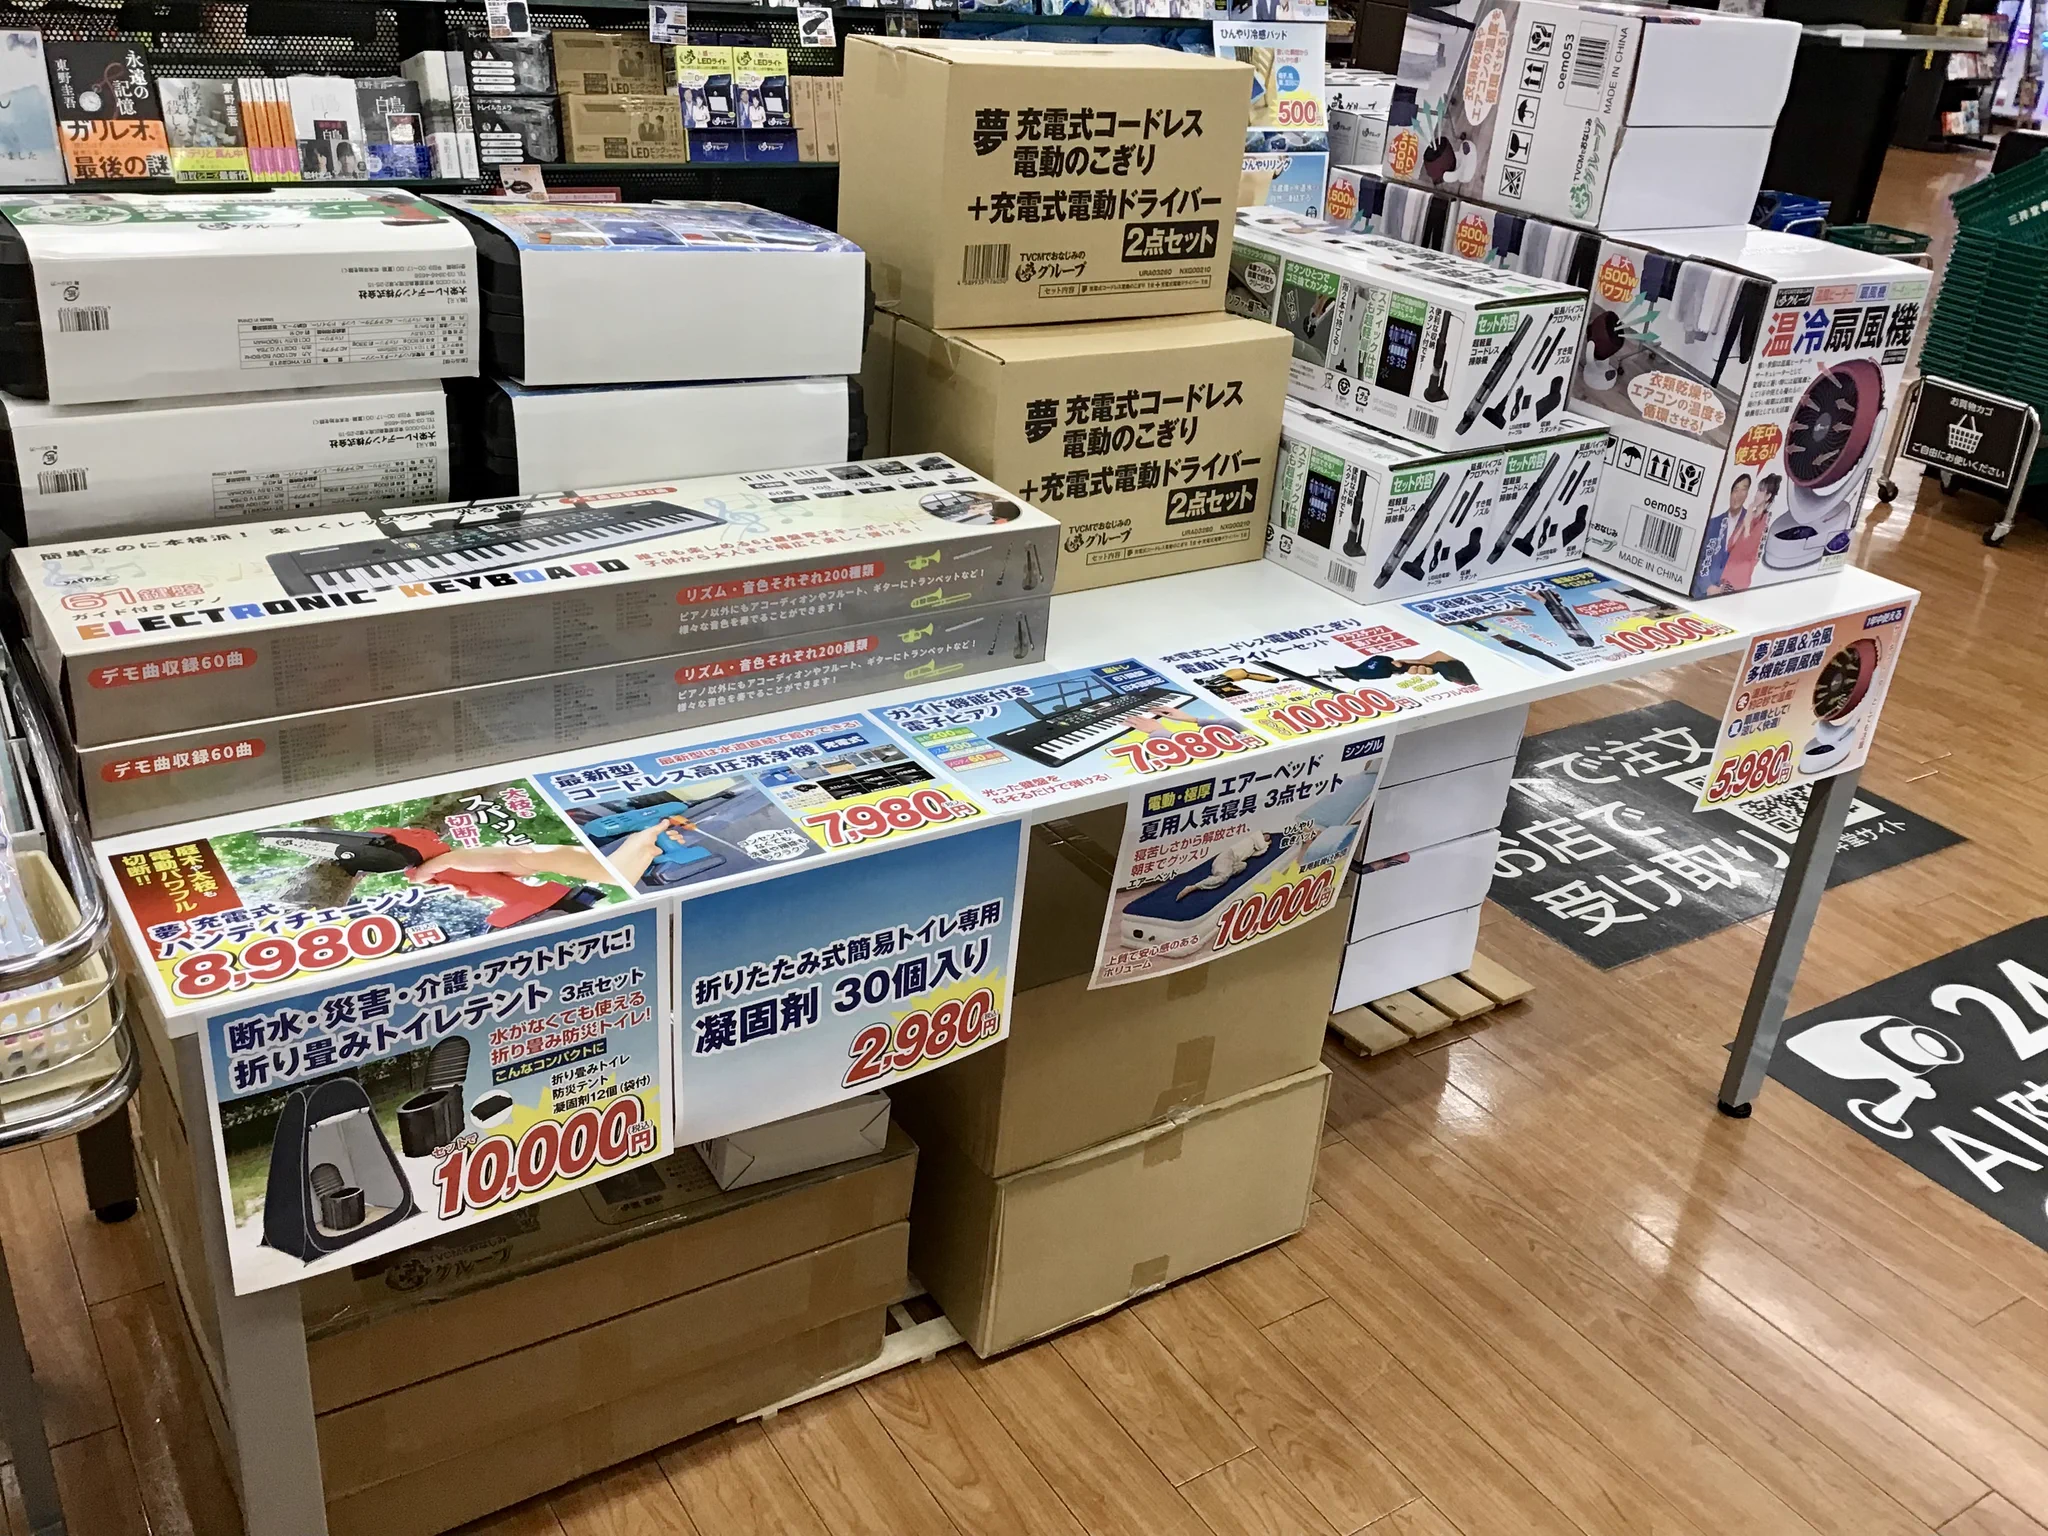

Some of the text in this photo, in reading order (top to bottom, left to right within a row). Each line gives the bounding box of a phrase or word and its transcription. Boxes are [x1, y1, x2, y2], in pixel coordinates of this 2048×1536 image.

[126, 50, 150, 99] 永遠の
[753, 58, 782, 66] LEDライト
[1471, 11, 1501, 121] エアコンの温度を
[1557, 33, 1576, 90] oem053
[1603, 80, 1618, 115] MADE
[1613, 26, 1629, 63] CHINA
[55, 58, 76, 109] 東野圭吾
[113, 80, 137, 116] 記憶
[222, 83, 239, 128] 東野圭吾
[375, 96, 406, 115] 白鳥
[451, 84, 474, 133] 架空犯
[973, 107, 1204, 156] 夢 充電式コードレス
[74, 155, 172, 179] 最後の謎
[631, 147, 649, 159] LED
[1013, 144, 1156, 178] 電動のこぎり
[1020, 250, 1086, 262] TVCMでおなじみの
[1125, 227, 1214, 257] 2点セット
[358, 285, 468, 300] 大栄トレーディング株式会社
[1860, 286, 1887, 299] 扇風機
[1364, 292, 1388, 381] スティック仕様
[1478, 312, 1520, 333] セット内容
[1762, 302, 1919, 358] 温冷扇風機
[1470, 346, 1500, 356] コードレス
[1554, 357, 1572, 365] ノズル
[1649, 370, 1713, 401] 衣類乾燥や
[1024, 380, 1244, 444] 夢 充電式コードレス
[1631, 383, 1725, 425] エアコンの温度を
[1642, 404, 1704, 435] 循環させる!
[1950, 396, 1995, 417] お買物カゴ
[329, 431, 436, 448] 大栄トレーディング株式会社
[1063, 416, 1199, 459] 電動のこぎり
[1507, 453, 1547, 473] セット内容
[1911, 441, 2006, 479] ご自由にお使いください
[1286, 445, 1308, 529] スティック仕様
[1392, 473, 1434, 493] セット内容
[1501, 484, 1529, 494] コードレス
[1579, 486, 1596, 496] ノズル
[1170, 484, 1253, 520] 2点セット
[1386, 504, 1417, 516] コードレス
[1472, 508, 1490, 518] ノズル
[1643, 496, 1689, 522] oem053
[1069, 518, 1132, 535] TVCMでおなじみの
[686, 563, 875, 603] リズム・音色それぞれ200種類
[1618, 550, 1684, 585] MADE IN CHINA
[61, 583, 206, 612] 61鍵盤
[72, 596, 222, 622] ガイド付きピアノ
[1436, 580, 1551, 610] 超軽量コードレス
[678, 602, 844, 635] 様々な音色を奏でることができます!
[1435, 601, 1526, 623] 掃除機セット
[1158, 618, 1363, 666] 充電式コードレス電動のこぎり
[1174, 637, 1330, 676] 電動ドライバーセット
[1753, 642, 1770, 661] 夢
[101, 651, 244, 686] デモ曲収録60曲
[683, 638, 869, 680] リズム・音色それぞれ200種類
[1746, 651, 1824, 684] 多機能扇風機
[677, 674, 837, 712] 様々な音色を奏でることができます!
[888, 685, 1033, 719] ガイド機能付き
[900, 706, 1001, 733] 電子ピアノ
[821, 735, 864, 751] 充電式
[1344, 739, 1384, 759] シングル
[114, 741, 253, 779] デモ曲収録60曲
[555, 763, 640, 790] 最新型
[567, 743, 819, 802] コードレス高圧洗浄機
[981, 773, 1061, 799] 光った鍵盤を
[992, 773, 1113, 806] なぞるだけで弾ける!
[1148, 752, 1325, 811] 電動・極厚 エアーベッド
[502, 787, 535, 818] 太枝も
[1138, 772, 1344, 843] 夏用人気寝具 3点セット
[459, 793, 534, 849] スパッと
[1133, 825, 1253, 863] 寝苦しさから解放され、
[174, 843, 219, 898] 庭木や太枝も
[1130, 846, 1210, 878] 朝までグッスリ
[148, 848, 198, 914] 電動パワフル
[152, 902, 284, 941] 夢 充電式
[162, 885, 451, 958] ハンディチェーンソー
[695, 899, 1002, 1007] 折りたたみ式簡易トイレ専用
[1105, 934, 1200, 967] 上質で安心感のある
[1102, 959, 1152, 978] ボリューム
[229, 927, 634, 1055] 断水・災害・介護・アウトドアに!
[695, 938, 990, 1055] 凝固剤 30個入り
[233, 969, 646, 1091] 折り畳みトイレテント 3点セット
[488, 991, 647, 1047] 水がなくても使える
[491, 1007, 652, 1068] 折り畳み防災トイレ!
[495, 1043, 605, 1083] こんなコンパクトに
[551, 1055, 631, 1086] 折り畳みトイレ
[552, 1075, 610, 1100] 防災テント
[431, 1134, 479, 1160] セットで
